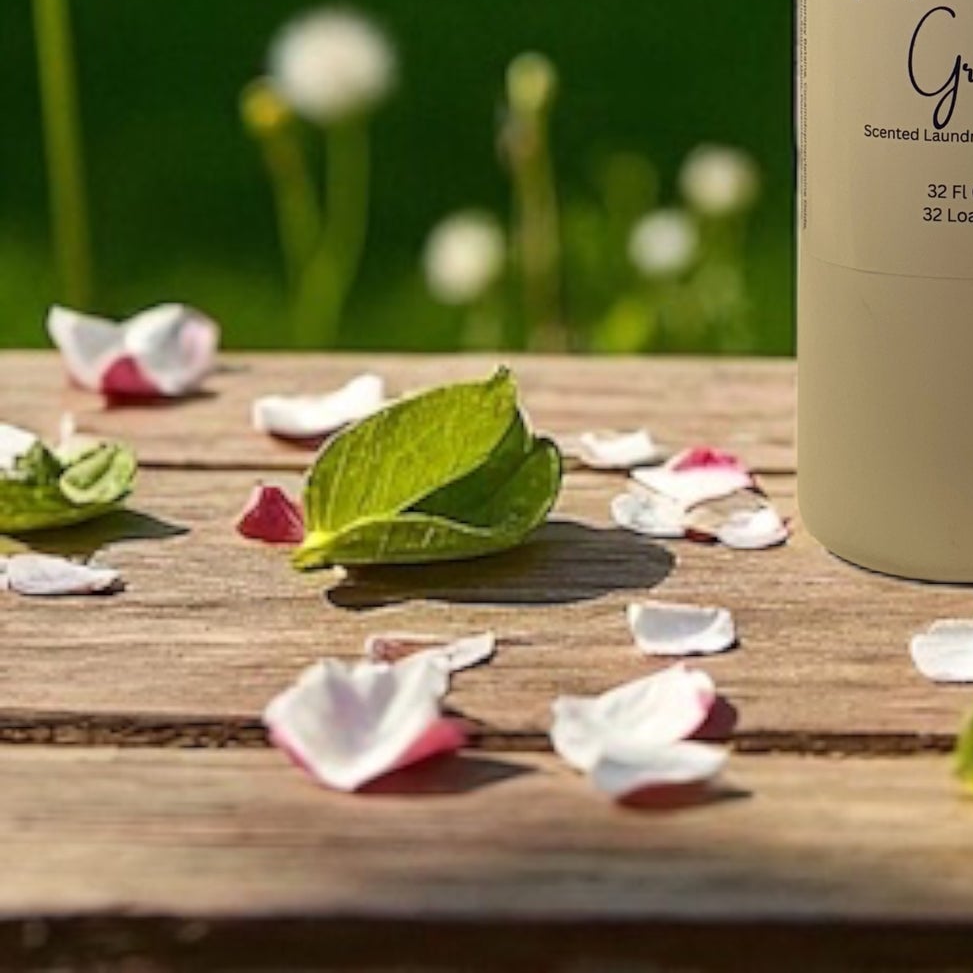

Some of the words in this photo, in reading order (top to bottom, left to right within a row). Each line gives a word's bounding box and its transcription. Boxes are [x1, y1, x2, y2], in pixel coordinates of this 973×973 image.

[864, 124, 919, 141] Scented
[927, 184, 947, 199] 32
[952, 184, 967, 200] Fl
[922, 207, 942, 222] 32
